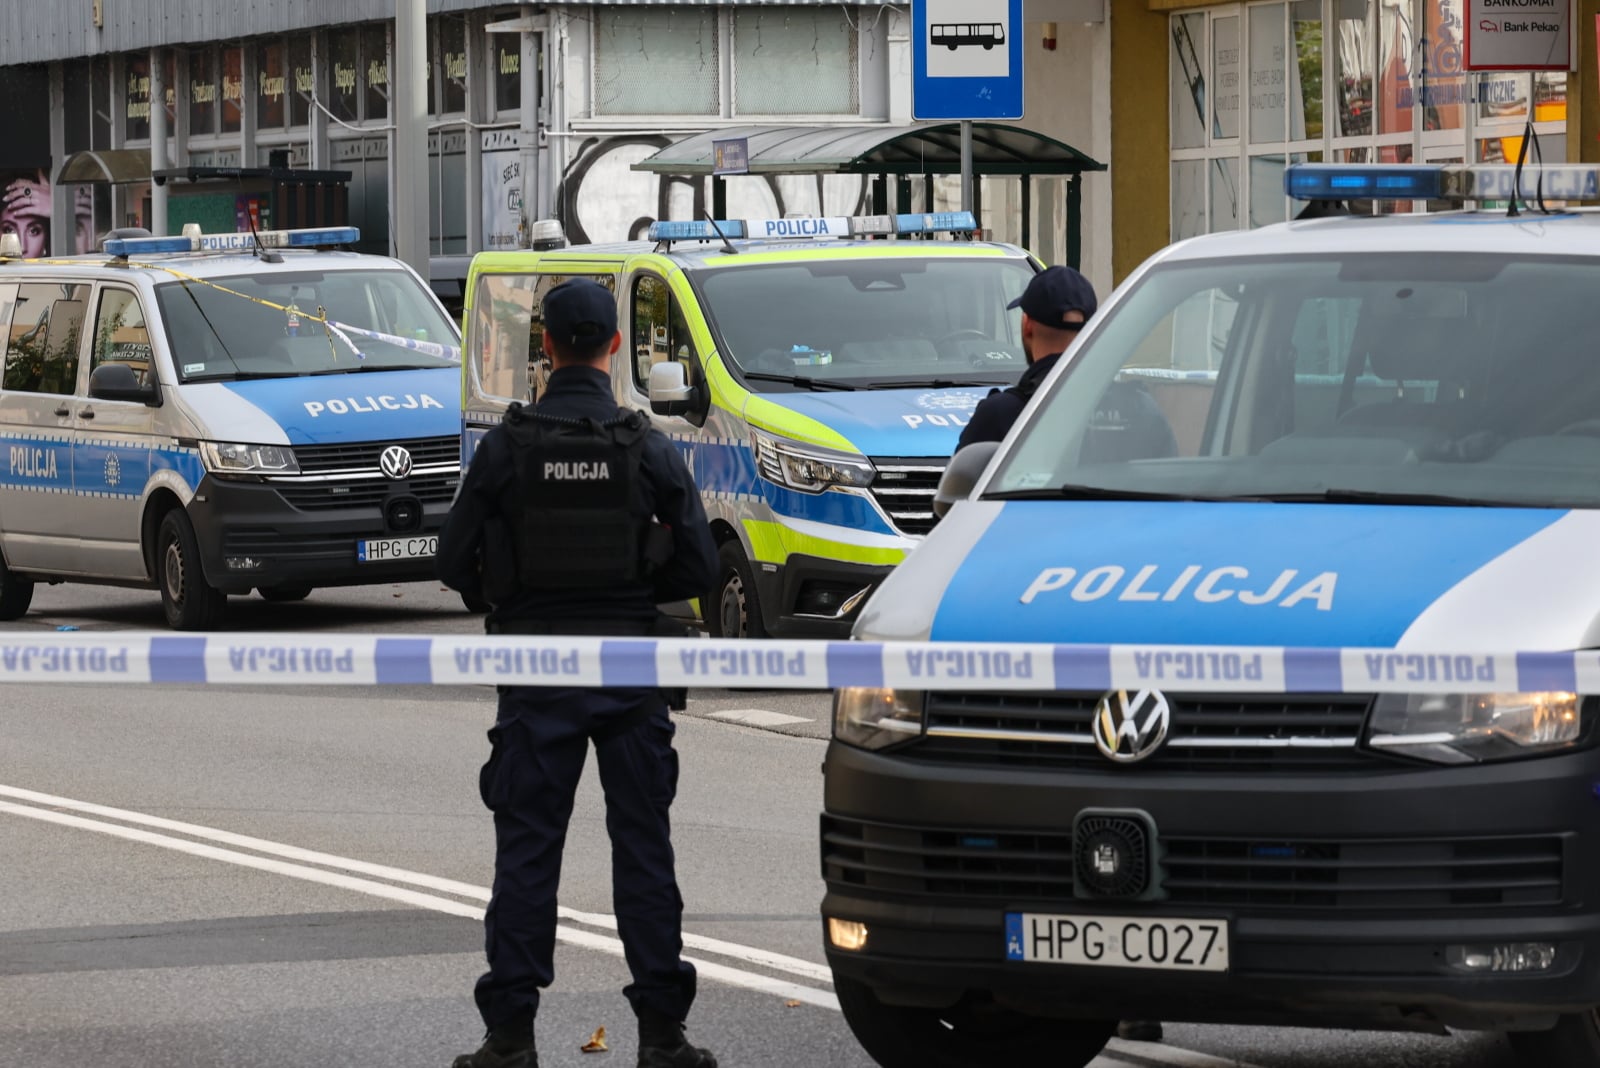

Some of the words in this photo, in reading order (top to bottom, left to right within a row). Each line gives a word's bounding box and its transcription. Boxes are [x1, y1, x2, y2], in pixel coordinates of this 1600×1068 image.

[1504, 22, 1529, 32] Bank
[1531, 22, 1560, 32] Pekao
[766, 219, 829, 235] POLICJA
[203, 234, 254, 249] POLICJA
[304, 394, 444, 417] POLICJA
[10, 446, 57, 479] POLICJA
[544, 462, 610, 480] POLICJA
[369, 540, 401, 559] HPG
[1020, 564, 1338, 611] POLICJA
[2, 645, 127, 673] POLICJA
[228, 646, 354, 673] POLICJA
[454, 647, 580, 675] POLICJA
[679, 648, 806, 677] POLICJA
[905, 649, 1033, 679] POLICJA
[1133, 651, 1263, 681] POLICJA
[1364, 653, 1496, 683] POLICJA
[1008, 942, 1022, 954] PL
[1032, 918, 1105, 961] HPG
[1122, 923, 1220, 966] C027
